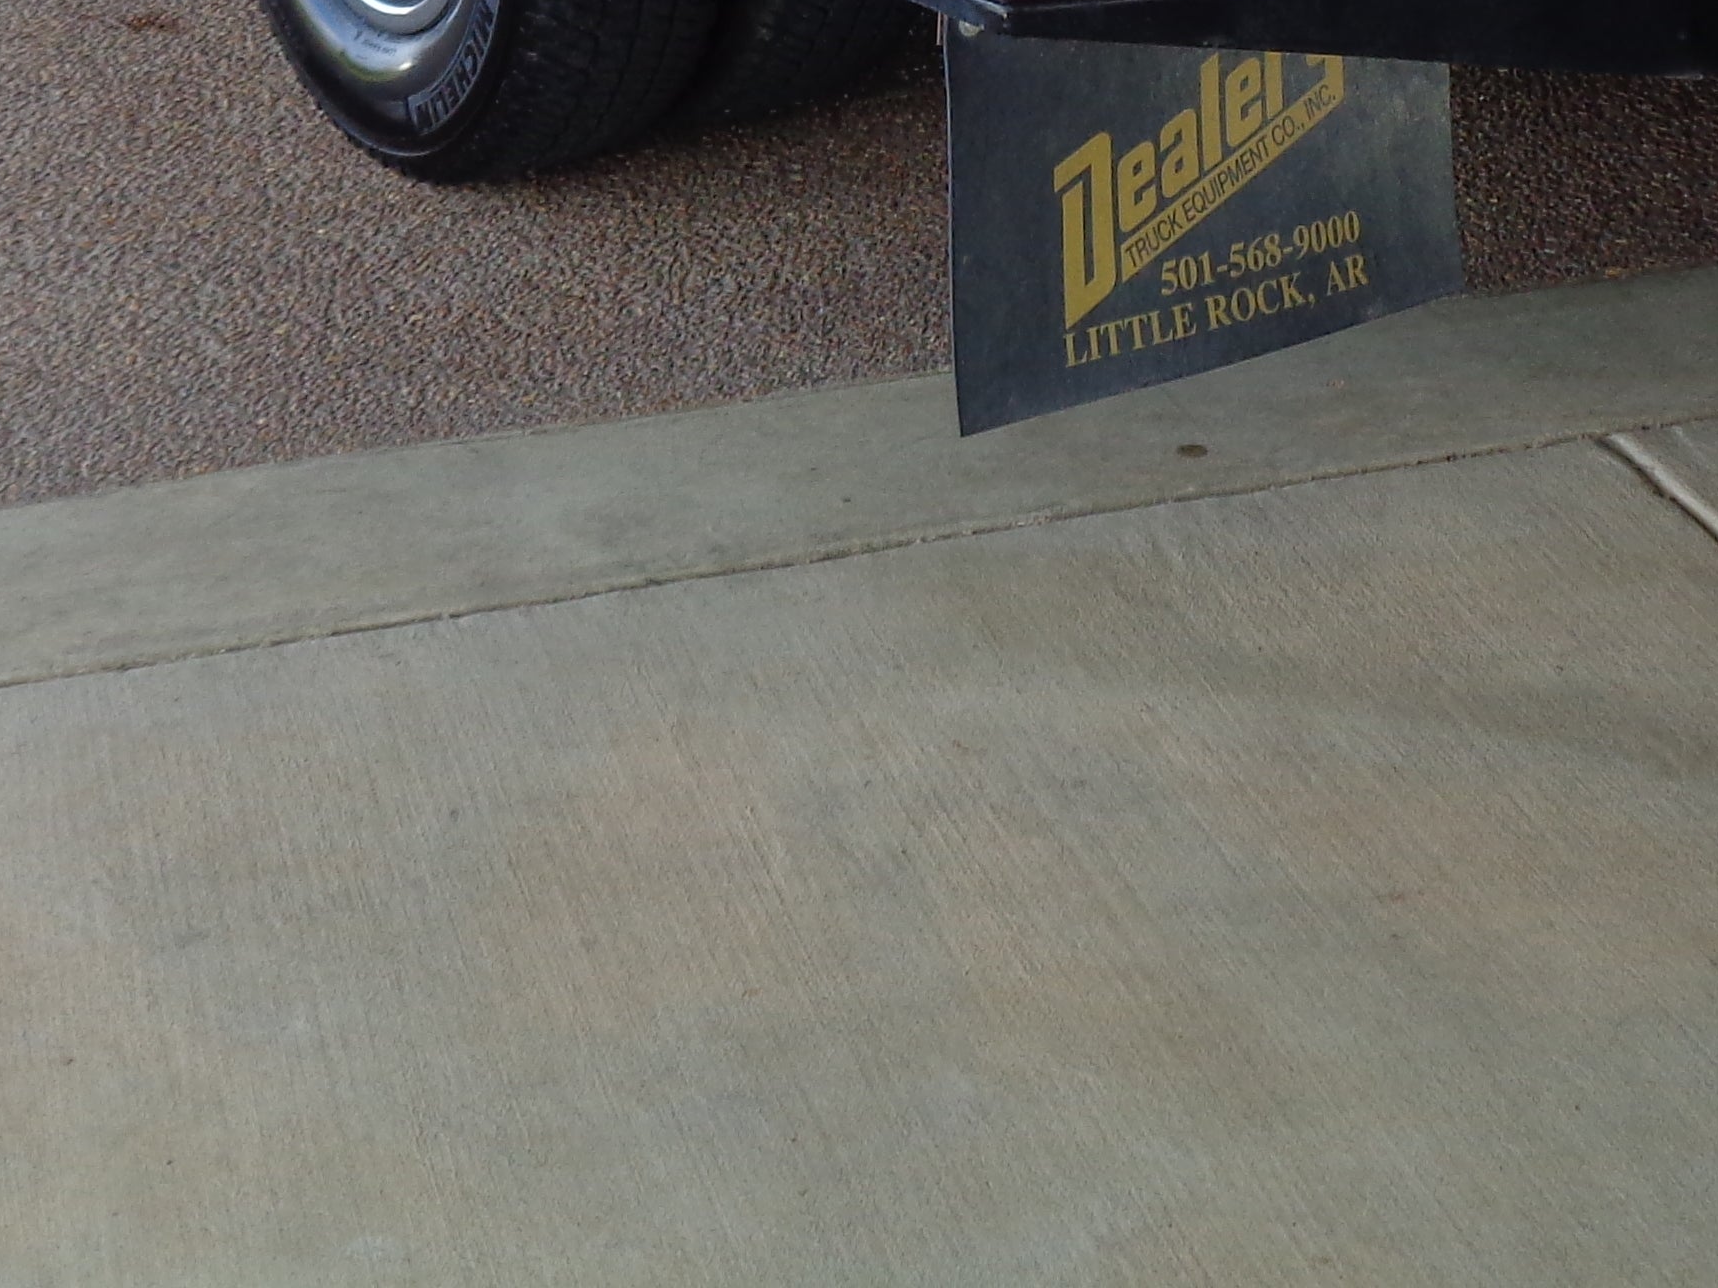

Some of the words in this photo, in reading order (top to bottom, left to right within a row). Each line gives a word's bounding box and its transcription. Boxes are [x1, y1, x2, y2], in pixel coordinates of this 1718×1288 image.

[1125, 211, 1184, 268] TRUCK
[1181, 137, 1271, 222] EQUIPMENT
[1304, 84, 1337, 122] INC.
[1063, 300, 1198, 368] LITTLE
[1204, 271, 1317, 331] ROCK,
[1326, 253, 1371, 297] AR
[1160, 210, 1362, 297] 501-568-9000
